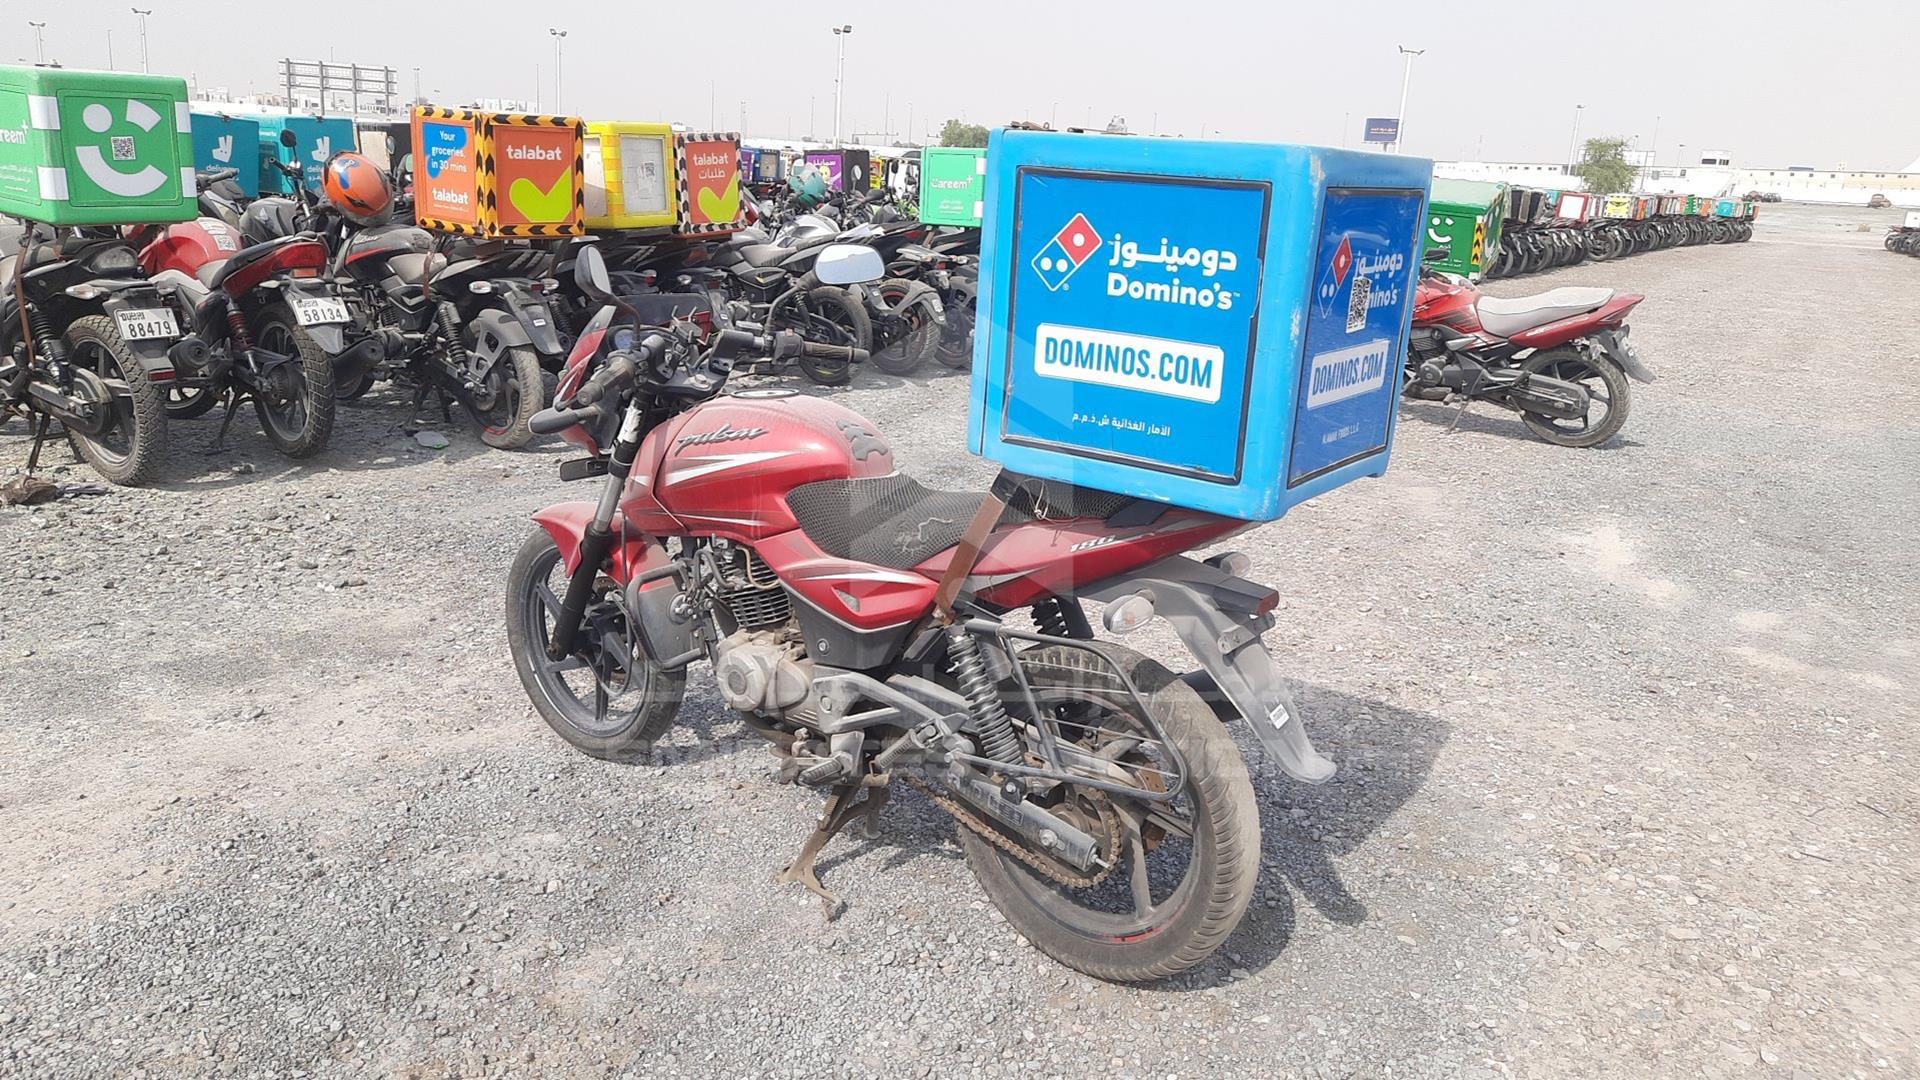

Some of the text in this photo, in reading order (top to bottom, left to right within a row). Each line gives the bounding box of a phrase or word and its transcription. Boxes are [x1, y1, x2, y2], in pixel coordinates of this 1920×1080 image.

[440, 130, 456, 141] Your
[506, 145, 562, 160] talabat
[693, 152, 728, 166] talabat
[431, 159, 468, 173] in 30 mins
[698, 168, 726, 182] طلبات
[432, 187, 469, 204] talabat
[1108, 233, 1238, 277] دومينوز
[1107, 272, 1233, 310] Domino's
[304, 308, 343, 322] 58134
[128, 321, 172, 338] 88479
[1044, 337, 1213, 388] DOMINOS.COM
[1312, 351, 1384, 396] DOMINOS.COM
